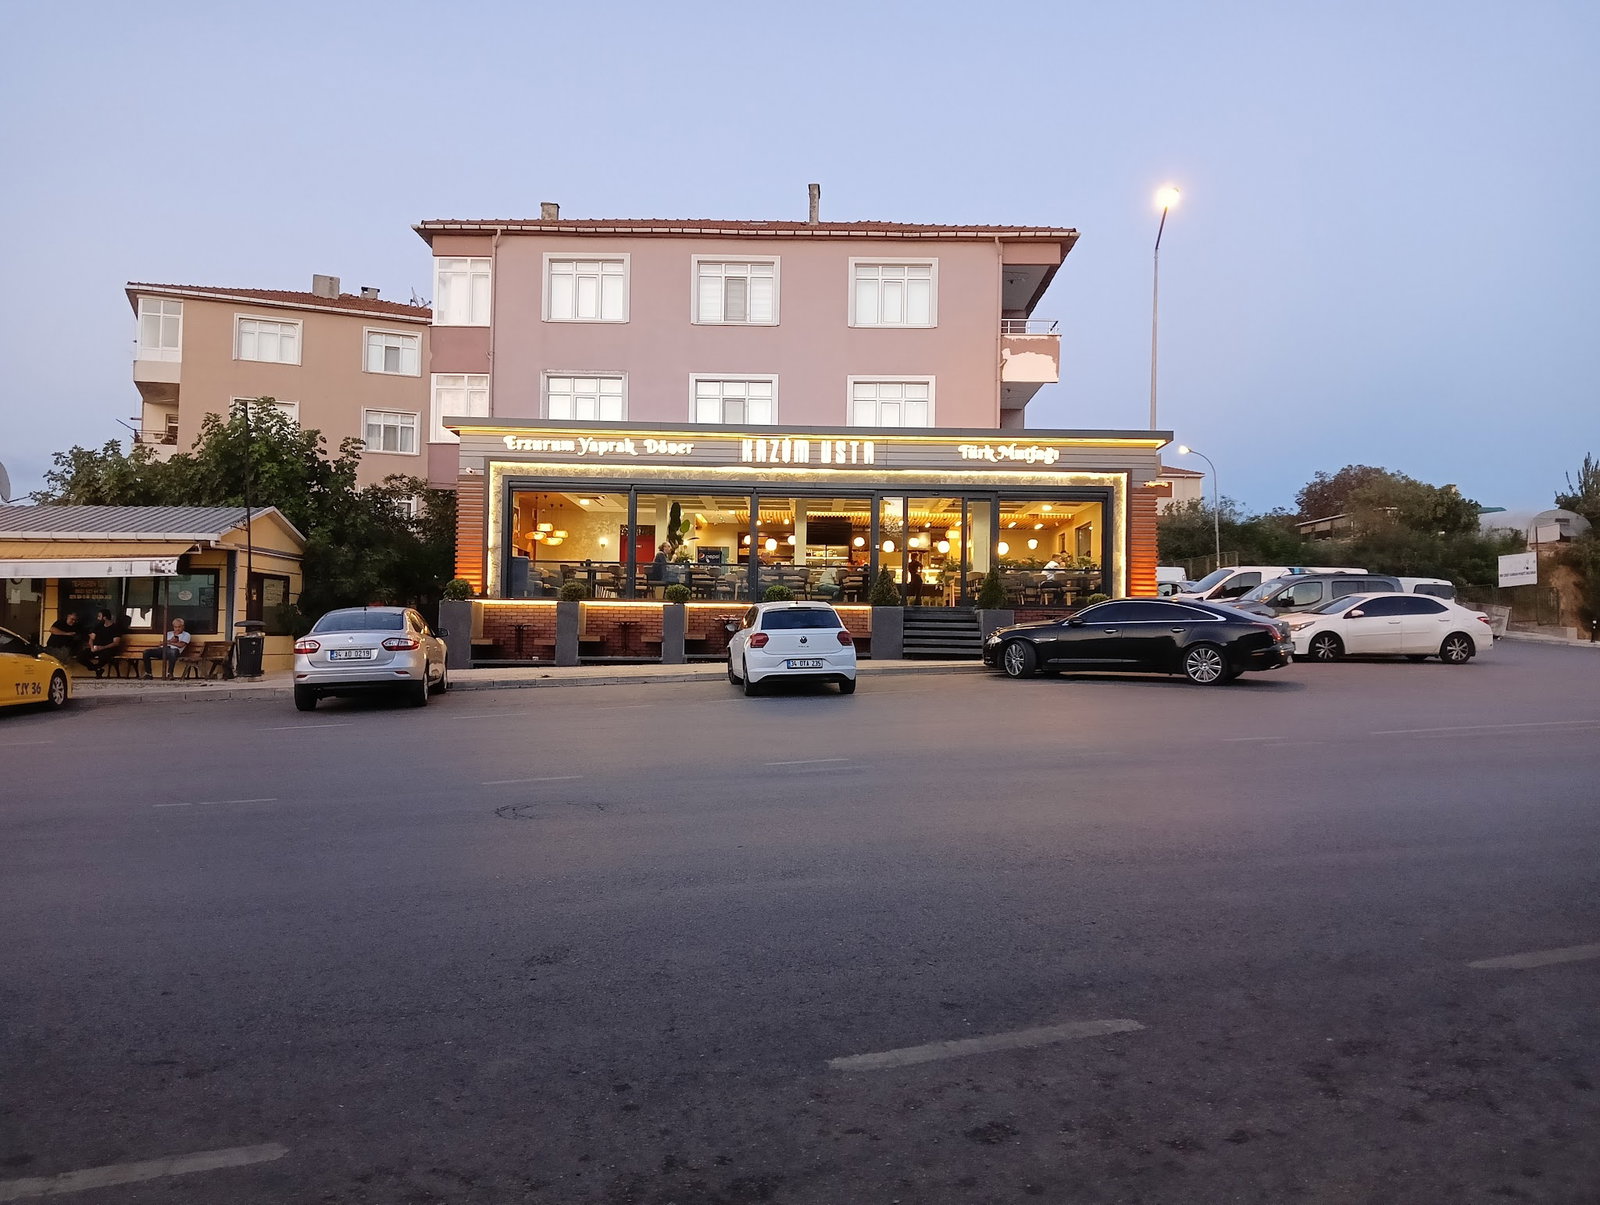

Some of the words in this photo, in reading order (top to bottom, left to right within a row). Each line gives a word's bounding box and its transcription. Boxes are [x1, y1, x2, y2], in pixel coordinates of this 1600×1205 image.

[503, 435, 576, 452] Erzurum
[577, 437, 638, 456] Yaprak
[643, 438, 695, 455] Döner
[820, 440, 875, 465] USTA
[957, 444, 999, 462] Türk
[31, 682, 41, 695] 36
